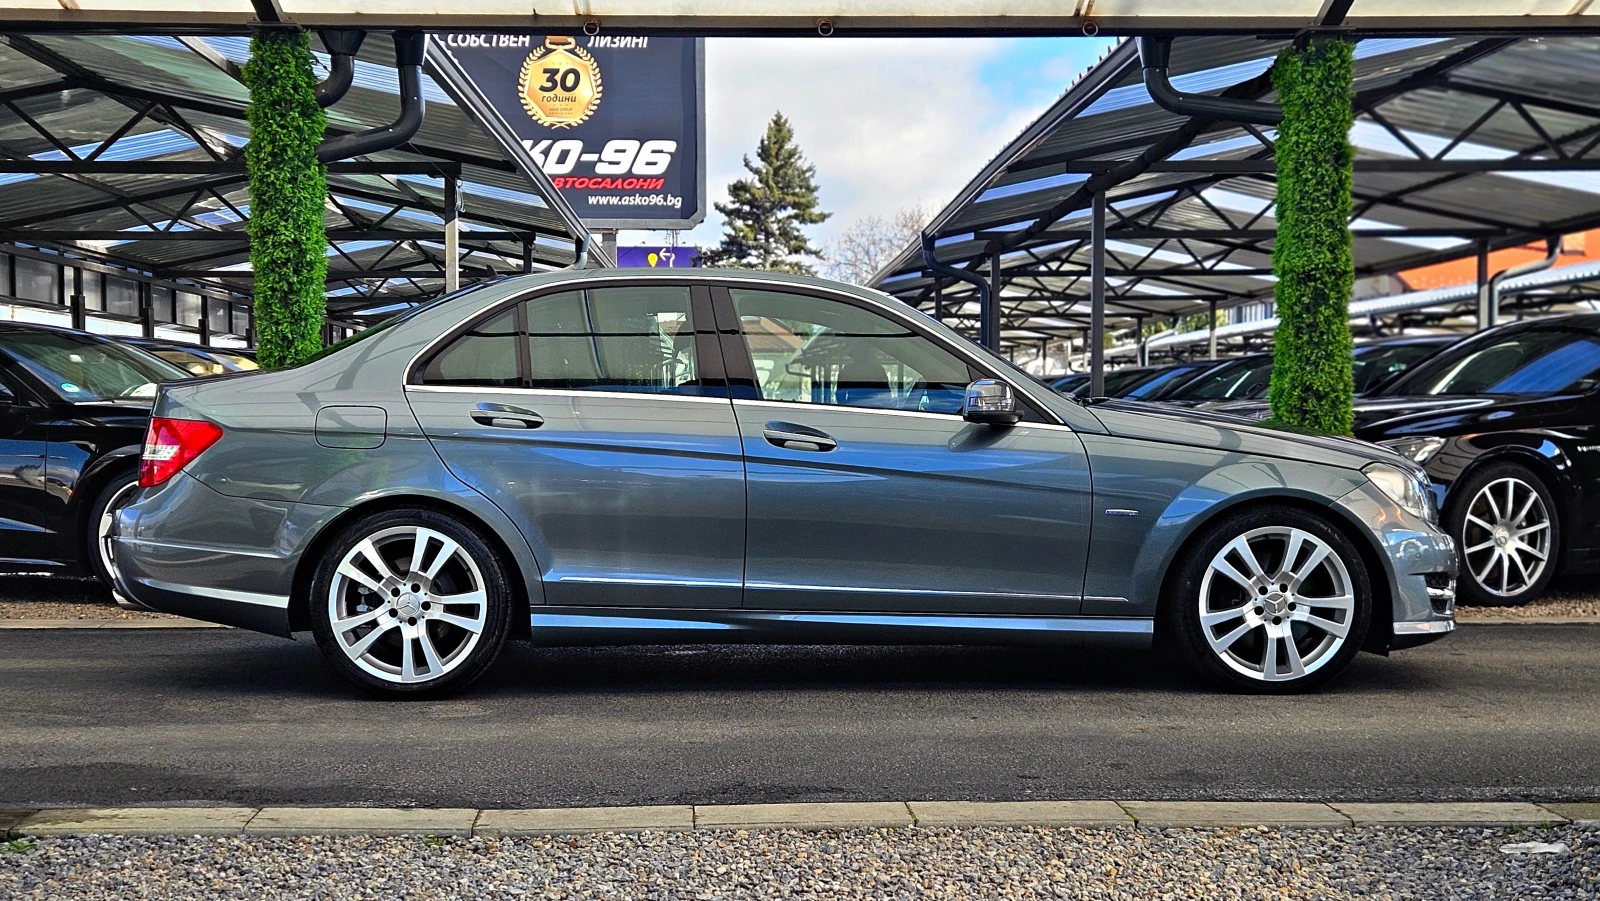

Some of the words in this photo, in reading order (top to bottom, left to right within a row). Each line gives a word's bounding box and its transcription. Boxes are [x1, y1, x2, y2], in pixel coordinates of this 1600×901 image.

[538, 68, 581, 92] 30
[541, 94, 577, 103] години
[551, 177, 665, 190] ВТОСАЛОНИ
[588, 193, 682, 209] www.asko96.bg
